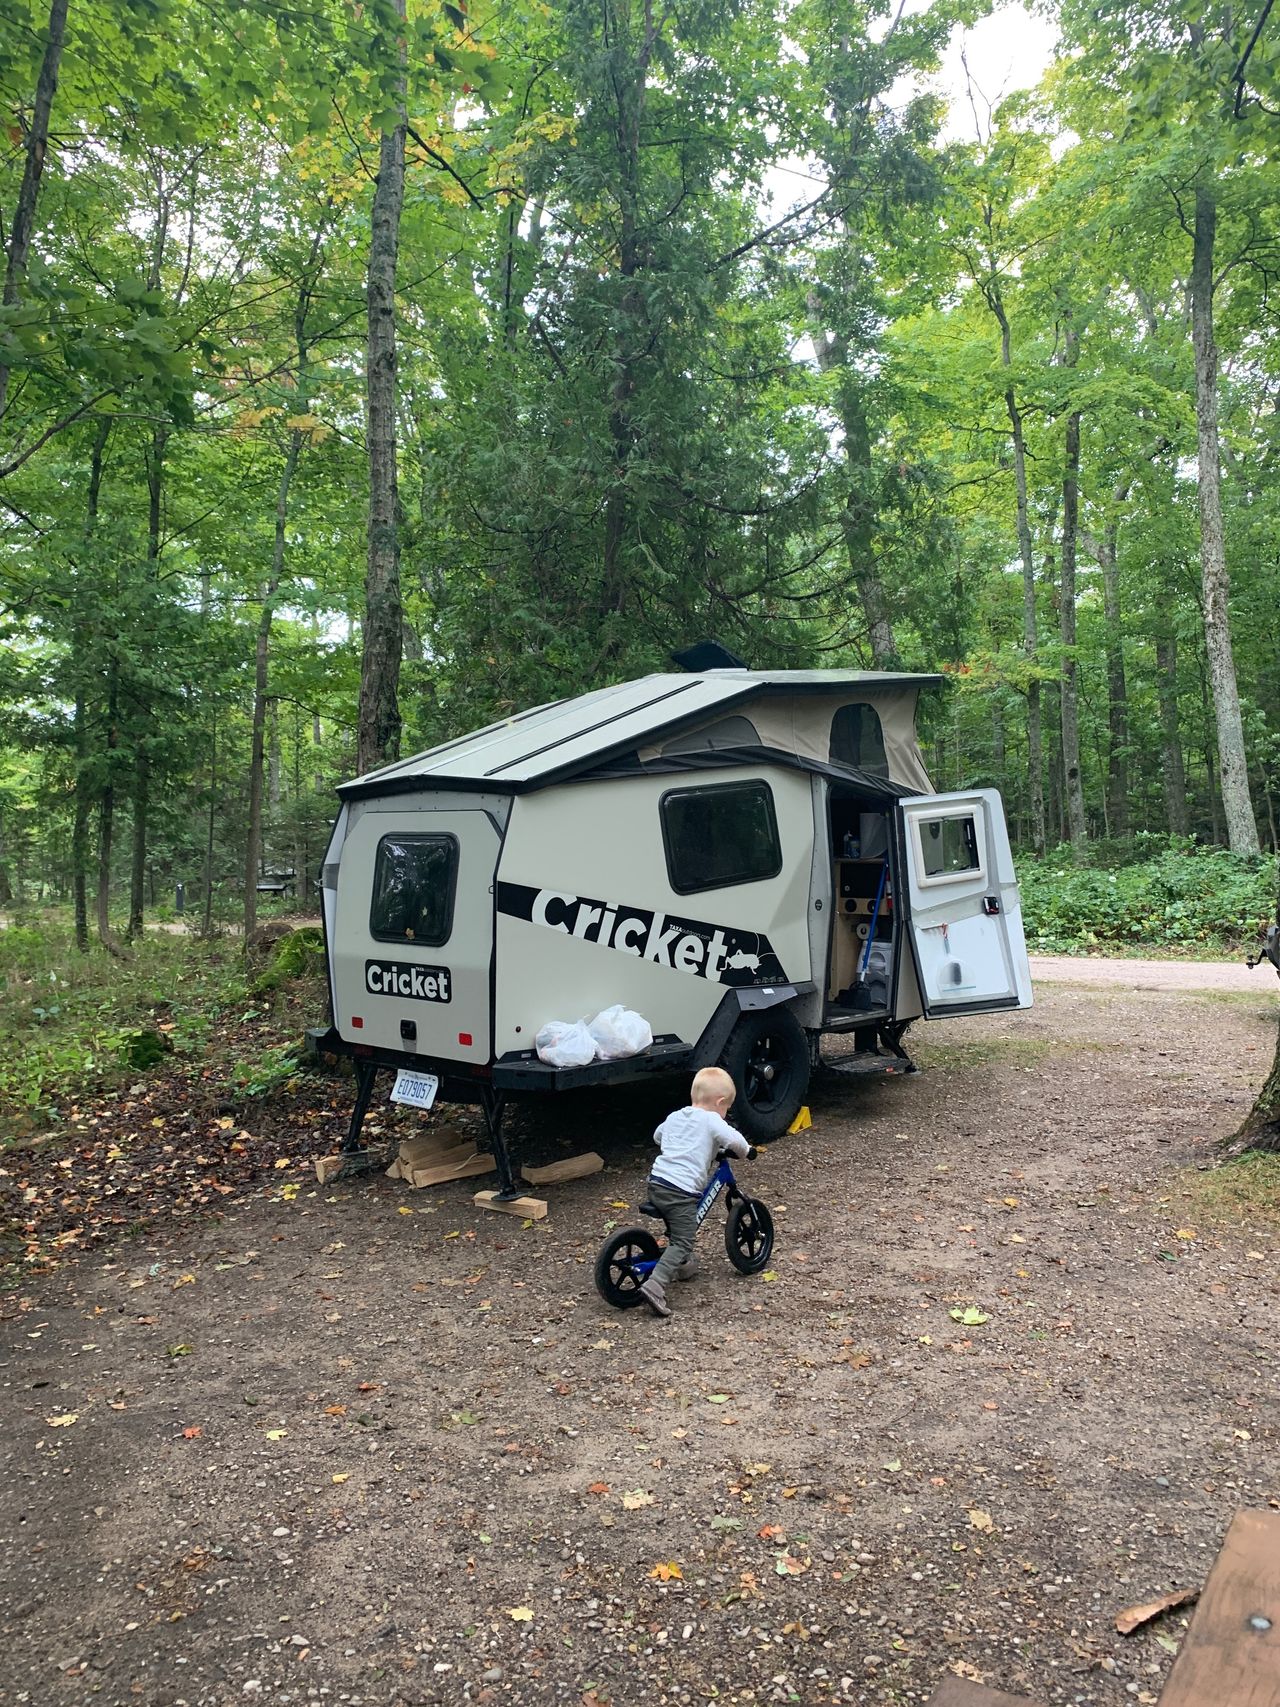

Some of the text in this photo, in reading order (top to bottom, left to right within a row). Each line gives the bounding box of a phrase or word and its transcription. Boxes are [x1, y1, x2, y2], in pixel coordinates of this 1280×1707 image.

[531, 889, 728, 982] Cricket
[367, 964, 448, 1000] Cricket
[397, 1078, 433, 1101] E079057
[695, 1180, 722, 1225] TRIDER
